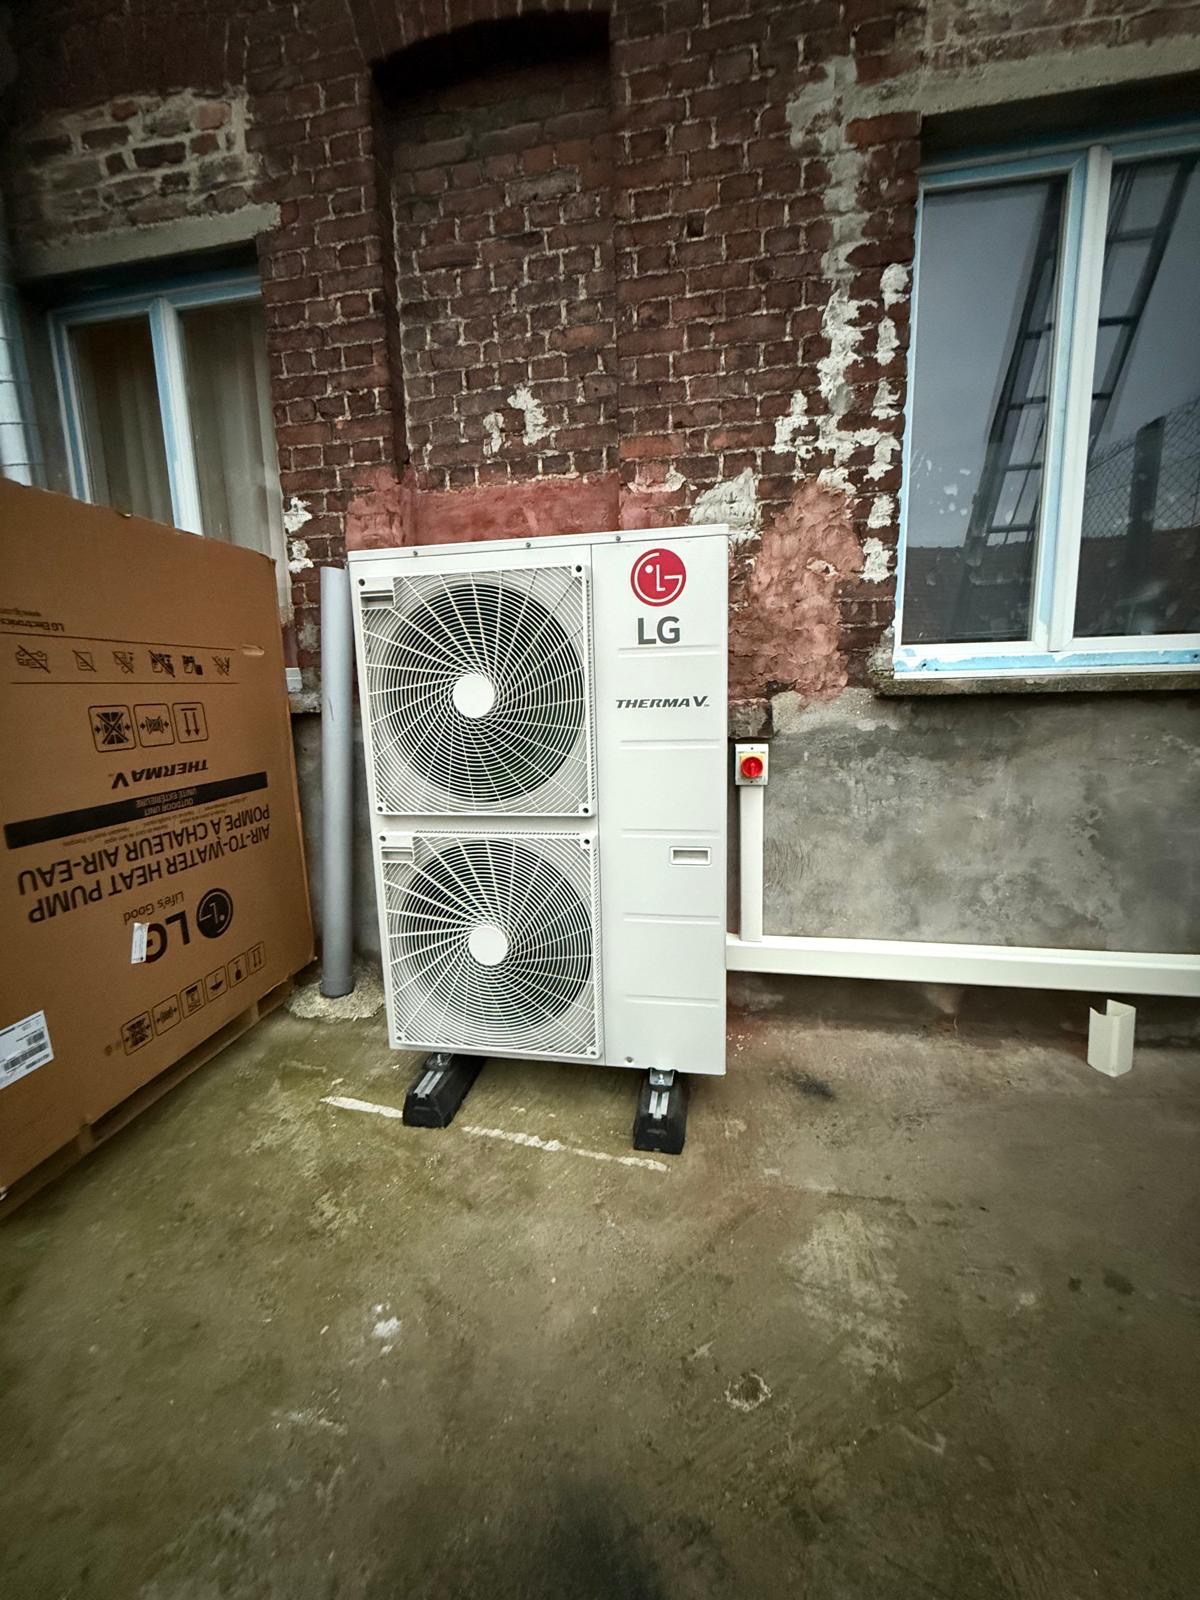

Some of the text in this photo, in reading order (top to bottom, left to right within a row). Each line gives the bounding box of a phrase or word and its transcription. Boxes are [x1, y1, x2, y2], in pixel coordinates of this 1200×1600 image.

[637, 616, 681, 645] LG
[616, 698, 690, 709] THERMA
[111, 759, 209, 789] THERMA V
[210, 817, 222, 840] À
[225, 804, 270, 832] POMPE
[124, 822, 208, 862] CHALEUR
[166, 823, 270, 868] AIR-TO-WATER
[18, 846, 119, 895] AIR-EAU
[108, 862, 162, 896] HEAT
[28, 880, 102, 923] PUMP
[123, 891, 185, 925] Life's Good
